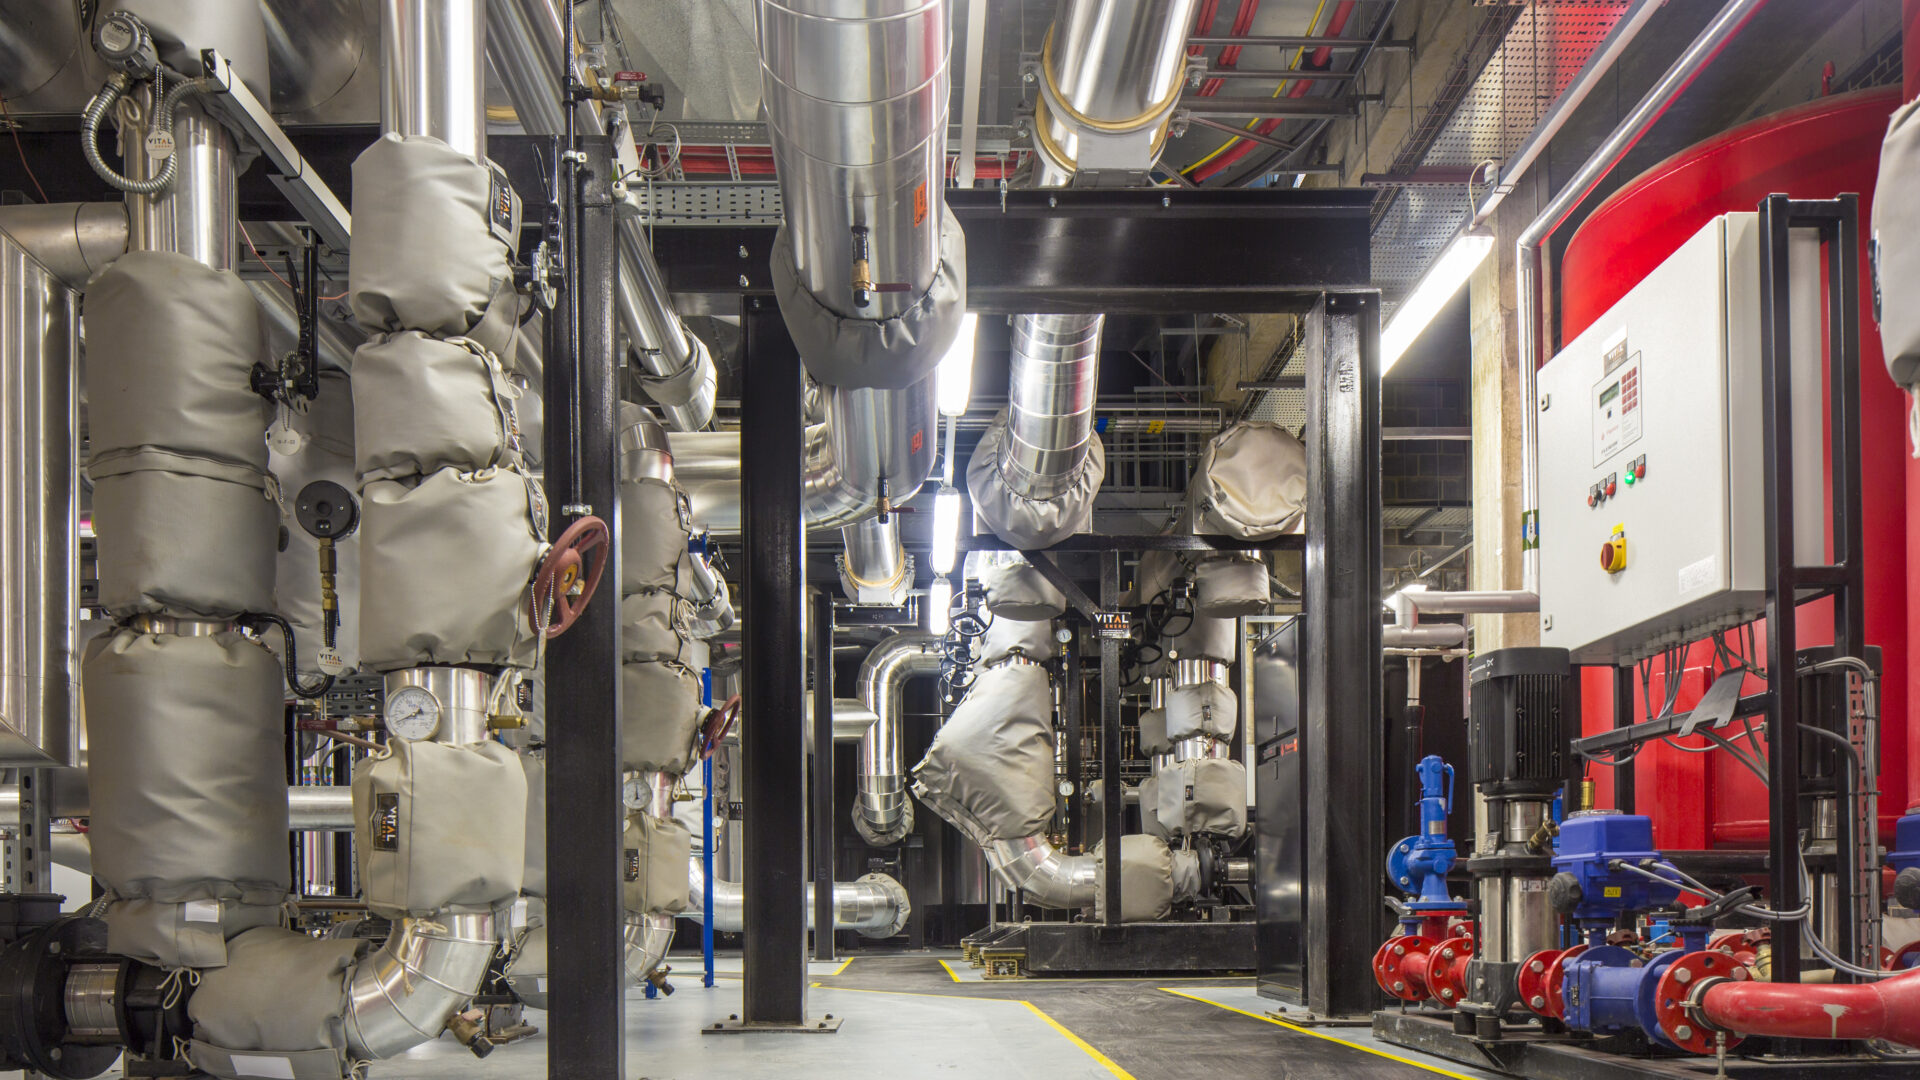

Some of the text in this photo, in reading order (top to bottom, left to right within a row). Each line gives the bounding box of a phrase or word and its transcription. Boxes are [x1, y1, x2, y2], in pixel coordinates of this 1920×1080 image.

[502, 187, 510, 220] VITAL
[1094, 614, 1129, 623] VITAL
[320, 653, 342, 662] VITAL
[386, 806, 397, 842] VITAL
